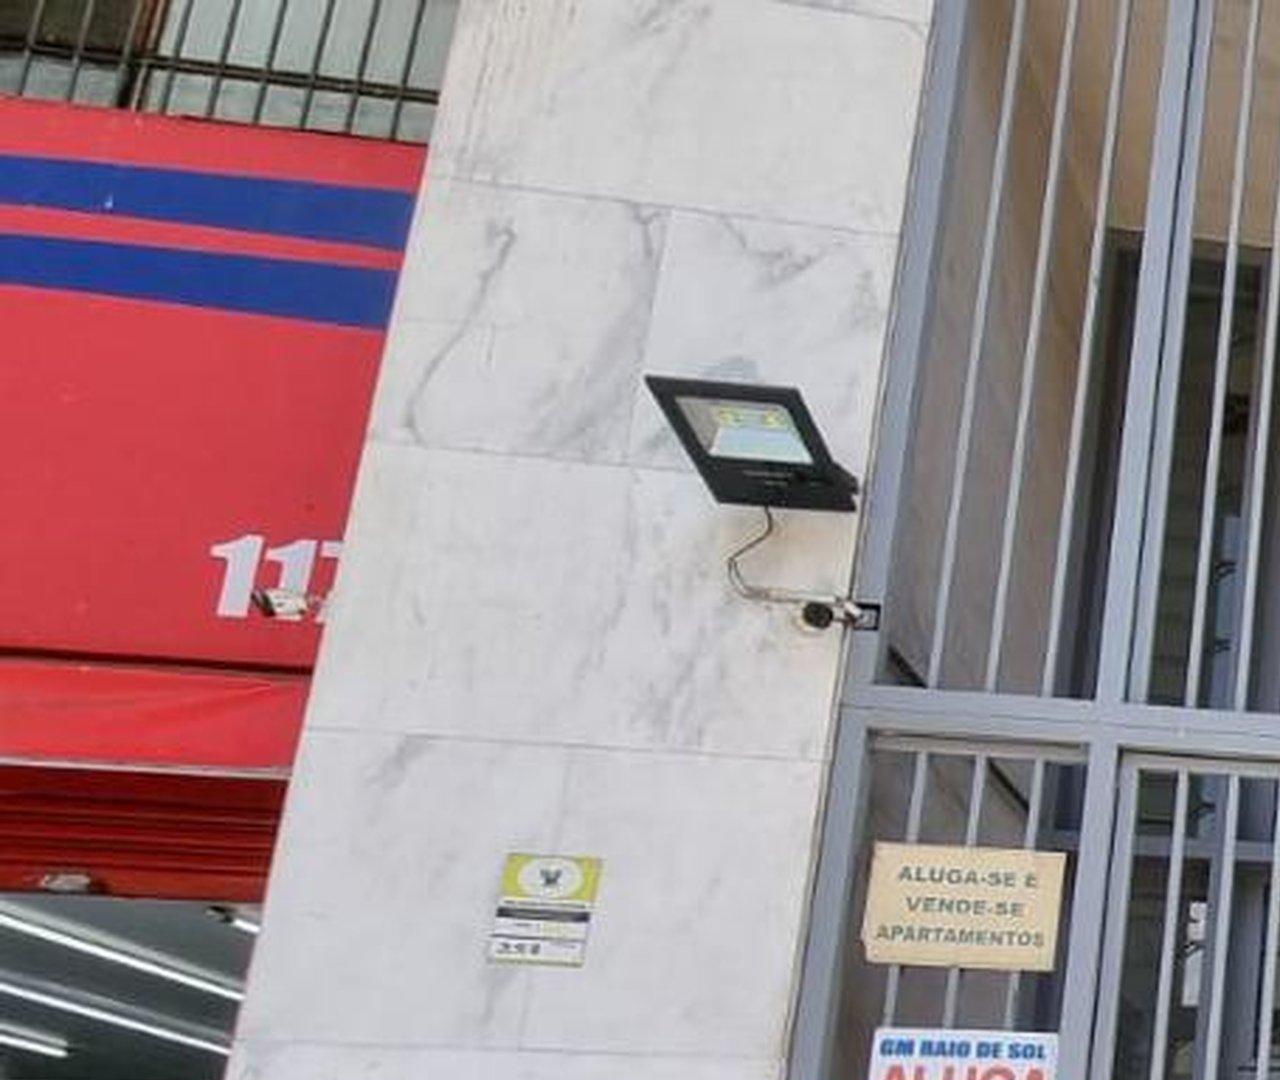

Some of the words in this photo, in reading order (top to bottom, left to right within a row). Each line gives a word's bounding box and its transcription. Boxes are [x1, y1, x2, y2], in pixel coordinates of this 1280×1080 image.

[898, 865, 1016, 888] ALUGA-SE
[1025, 873, 1037, 888] E
[905, 896, 1024, 917] VENDE-SE
[876, 922, 1045, 949] APARTAMENTOS
[976, 1041, 1005, 1059] DE
[1008, 1042, 1047, 1060] SOL
